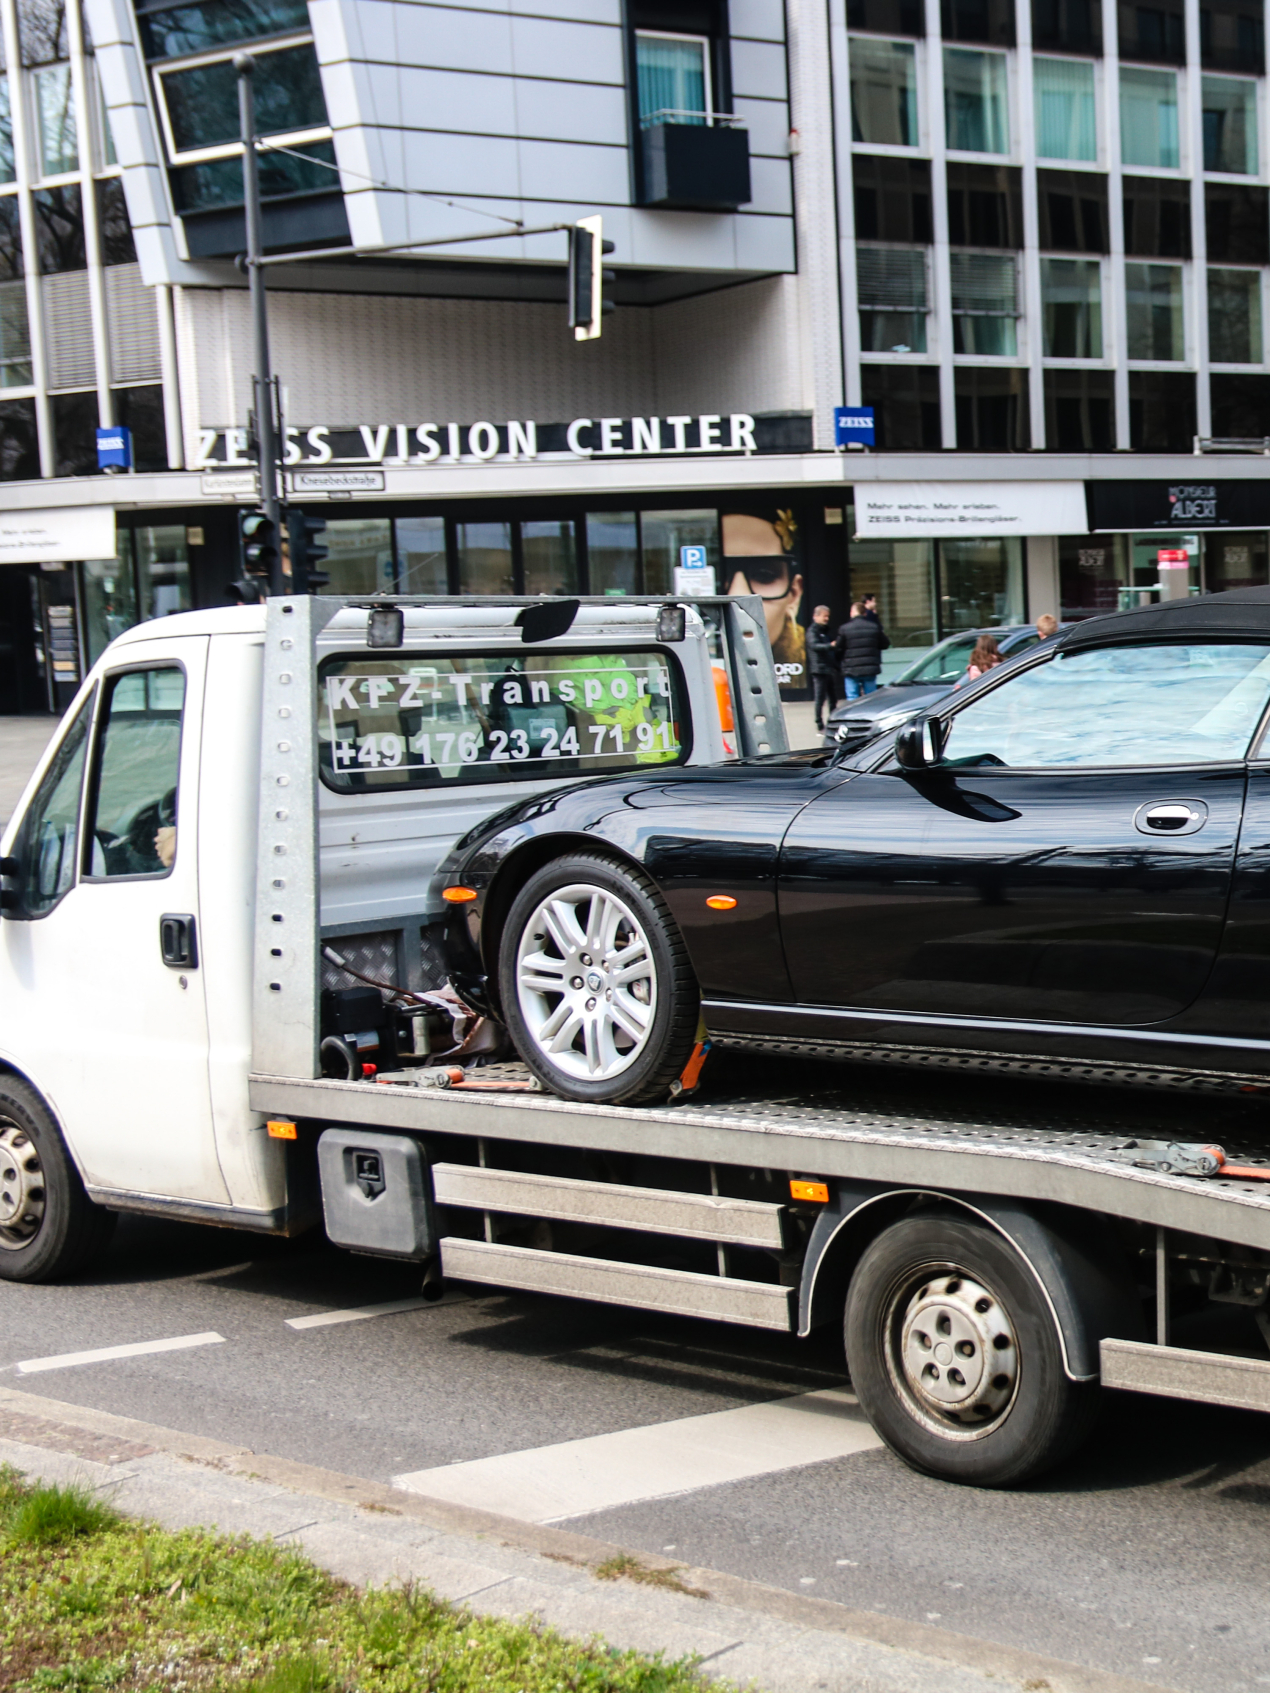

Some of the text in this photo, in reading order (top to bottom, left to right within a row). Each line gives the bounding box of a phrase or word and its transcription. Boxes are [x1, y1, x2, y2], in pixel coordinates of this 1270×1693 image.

[838, 416, 874, 428] ZEISS
[195, 413, 757, 466] ZESS VISION CENTER
[867, 502, 894, 510] Mehr
[933, 502, 959, 510] Mehr
[1170, 500, 1217, 518] ALBERT
[868, 515, 900, 523] ZEISS
[686, 550, 701, 567] P
[774, 663, 803, 675] ORD
[332, 676, 671, 710] KFZ-Transport
[337, 722, 671, 767] +49 176 23 24 71 91
